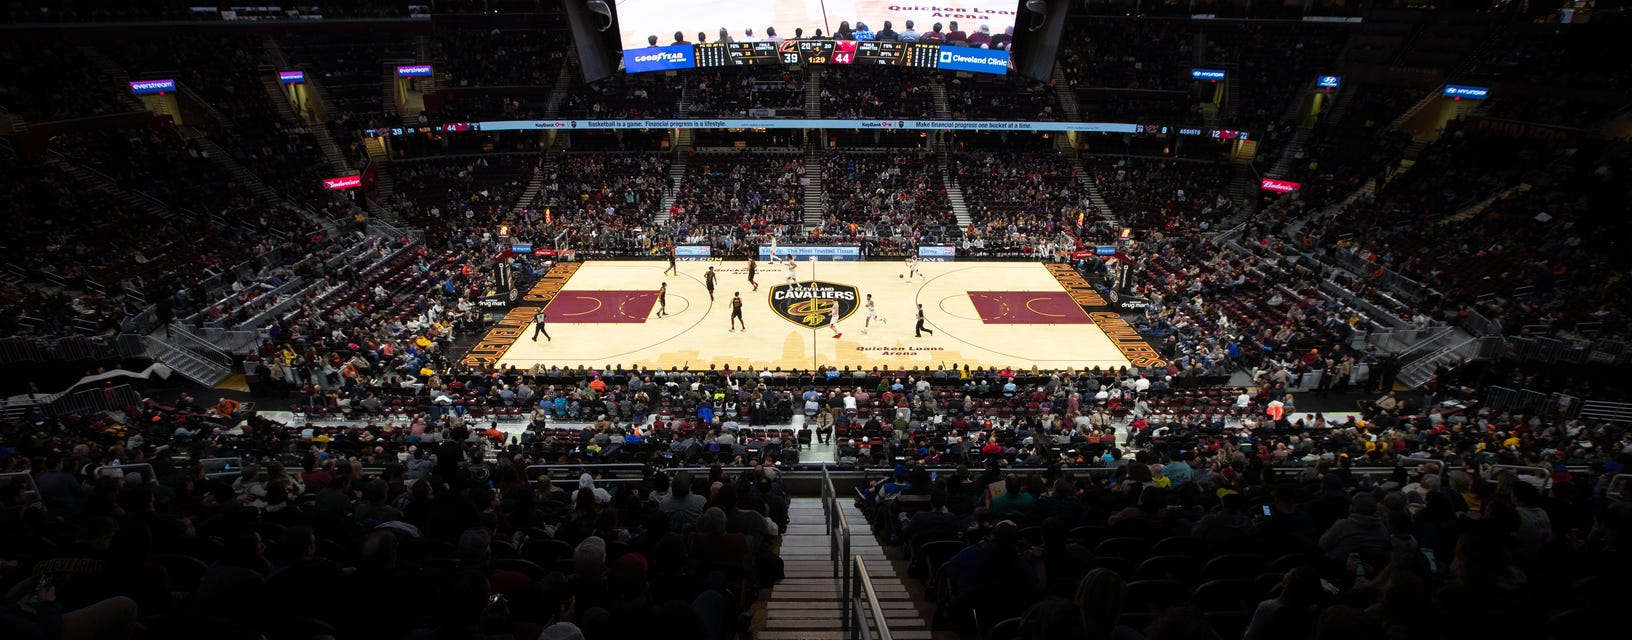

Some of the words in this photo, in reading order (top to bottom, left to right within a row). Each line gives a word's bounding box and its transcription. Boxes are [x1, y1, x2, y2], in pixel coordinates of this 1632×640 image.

[932, 12, 989, 20] Arena
[634, 52, 683, 62] GOODYEAR
[784, 53, 798, 63] 39
[835, 53, 850, 63] 44
[952, 54, 986, 64] Cleveland
[987, 57, 1008, 67] Clinic
[133, 81, 172, 89] everstream
[775, 291, 854, 300] CAVALIERS
[1089, 312, 1167, 367] CAVALIERS
